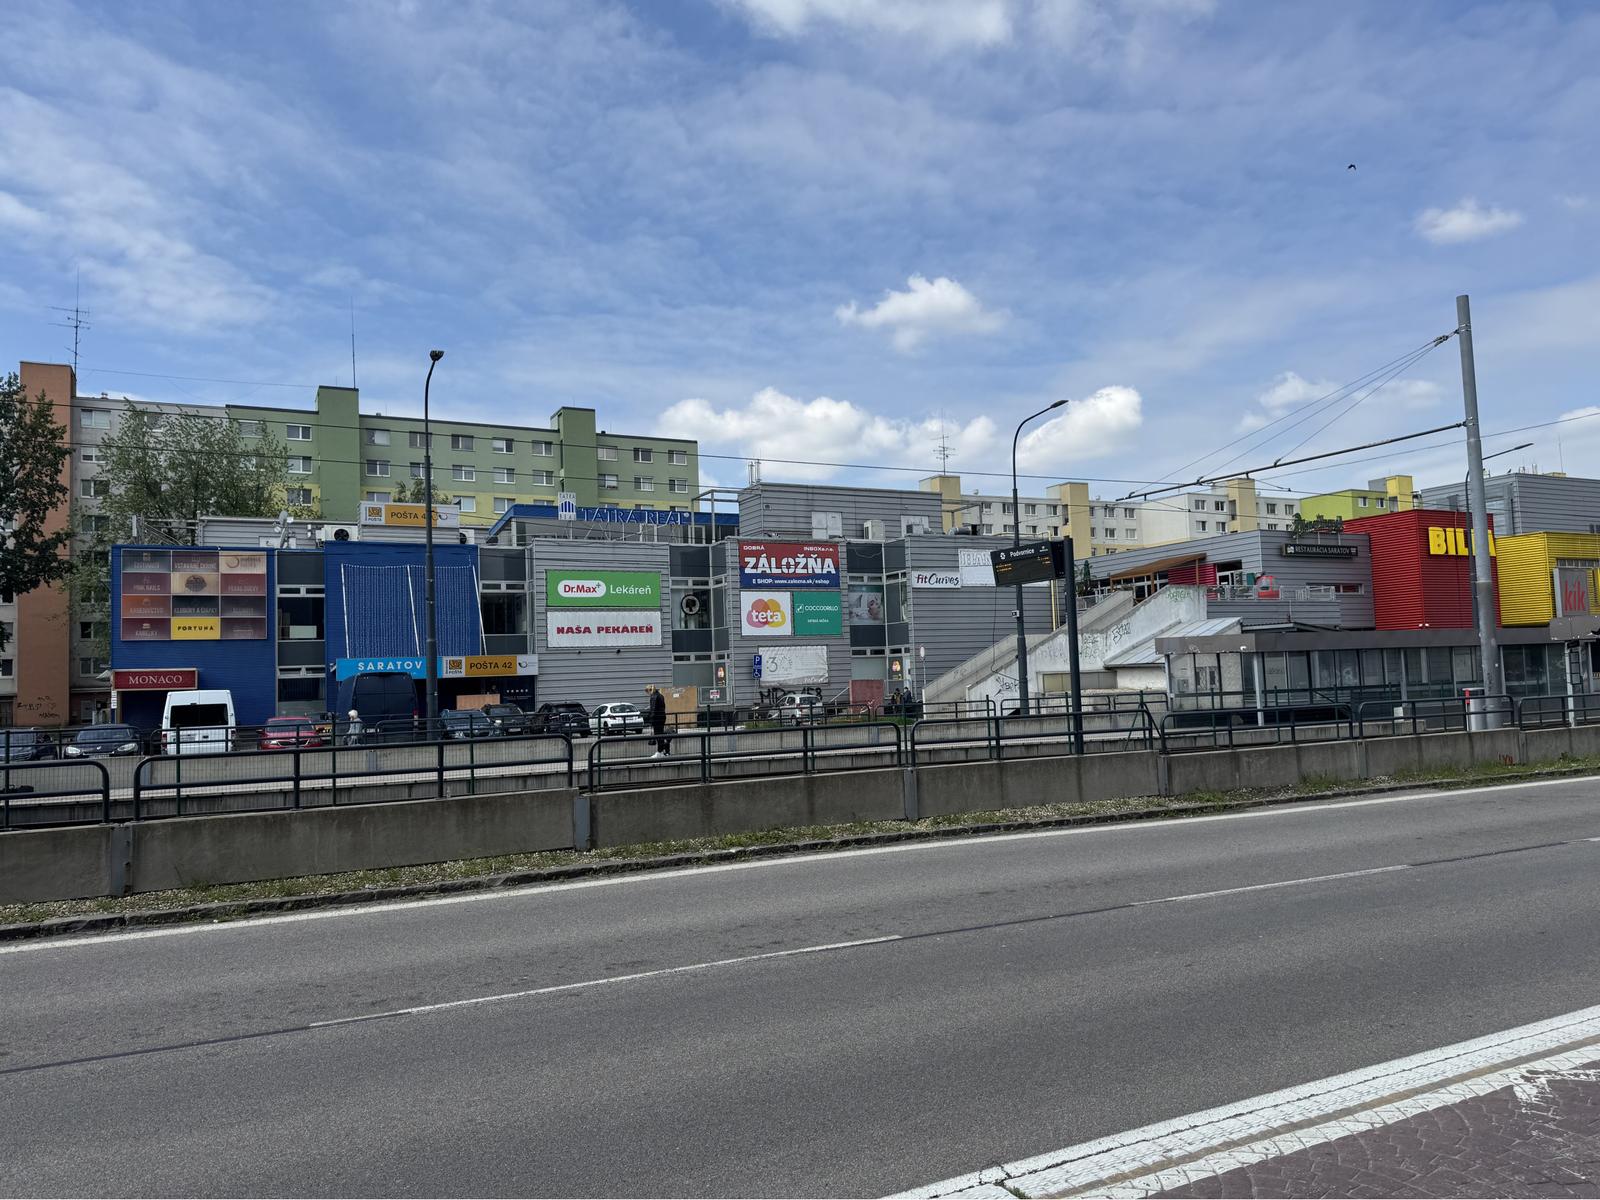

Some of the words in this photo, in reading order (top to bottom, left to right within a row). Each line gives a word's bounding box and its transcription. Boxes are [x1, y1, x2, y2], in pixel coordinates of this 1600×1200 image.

[391, 511, 419, 519] POŠTA
[581, 508, 637, 523] TATRA
[645, 511, 681, 525] REAL
[744, 553, 836, 574] ZÁLOŽŇA
[610, 584, 652, 595] Lekáreň
[751, 609, 782, 623] teta
[556, 624, 592, 635] NAŠA
[597, 623, 653, 634] PEKÁREŇ
[358, 661, 422, 670] SARATOV
[469, 661, 499, 670] POŠTA
[502, 661, 513, 669] 42
[128, 675, 183, 685] MONACO
